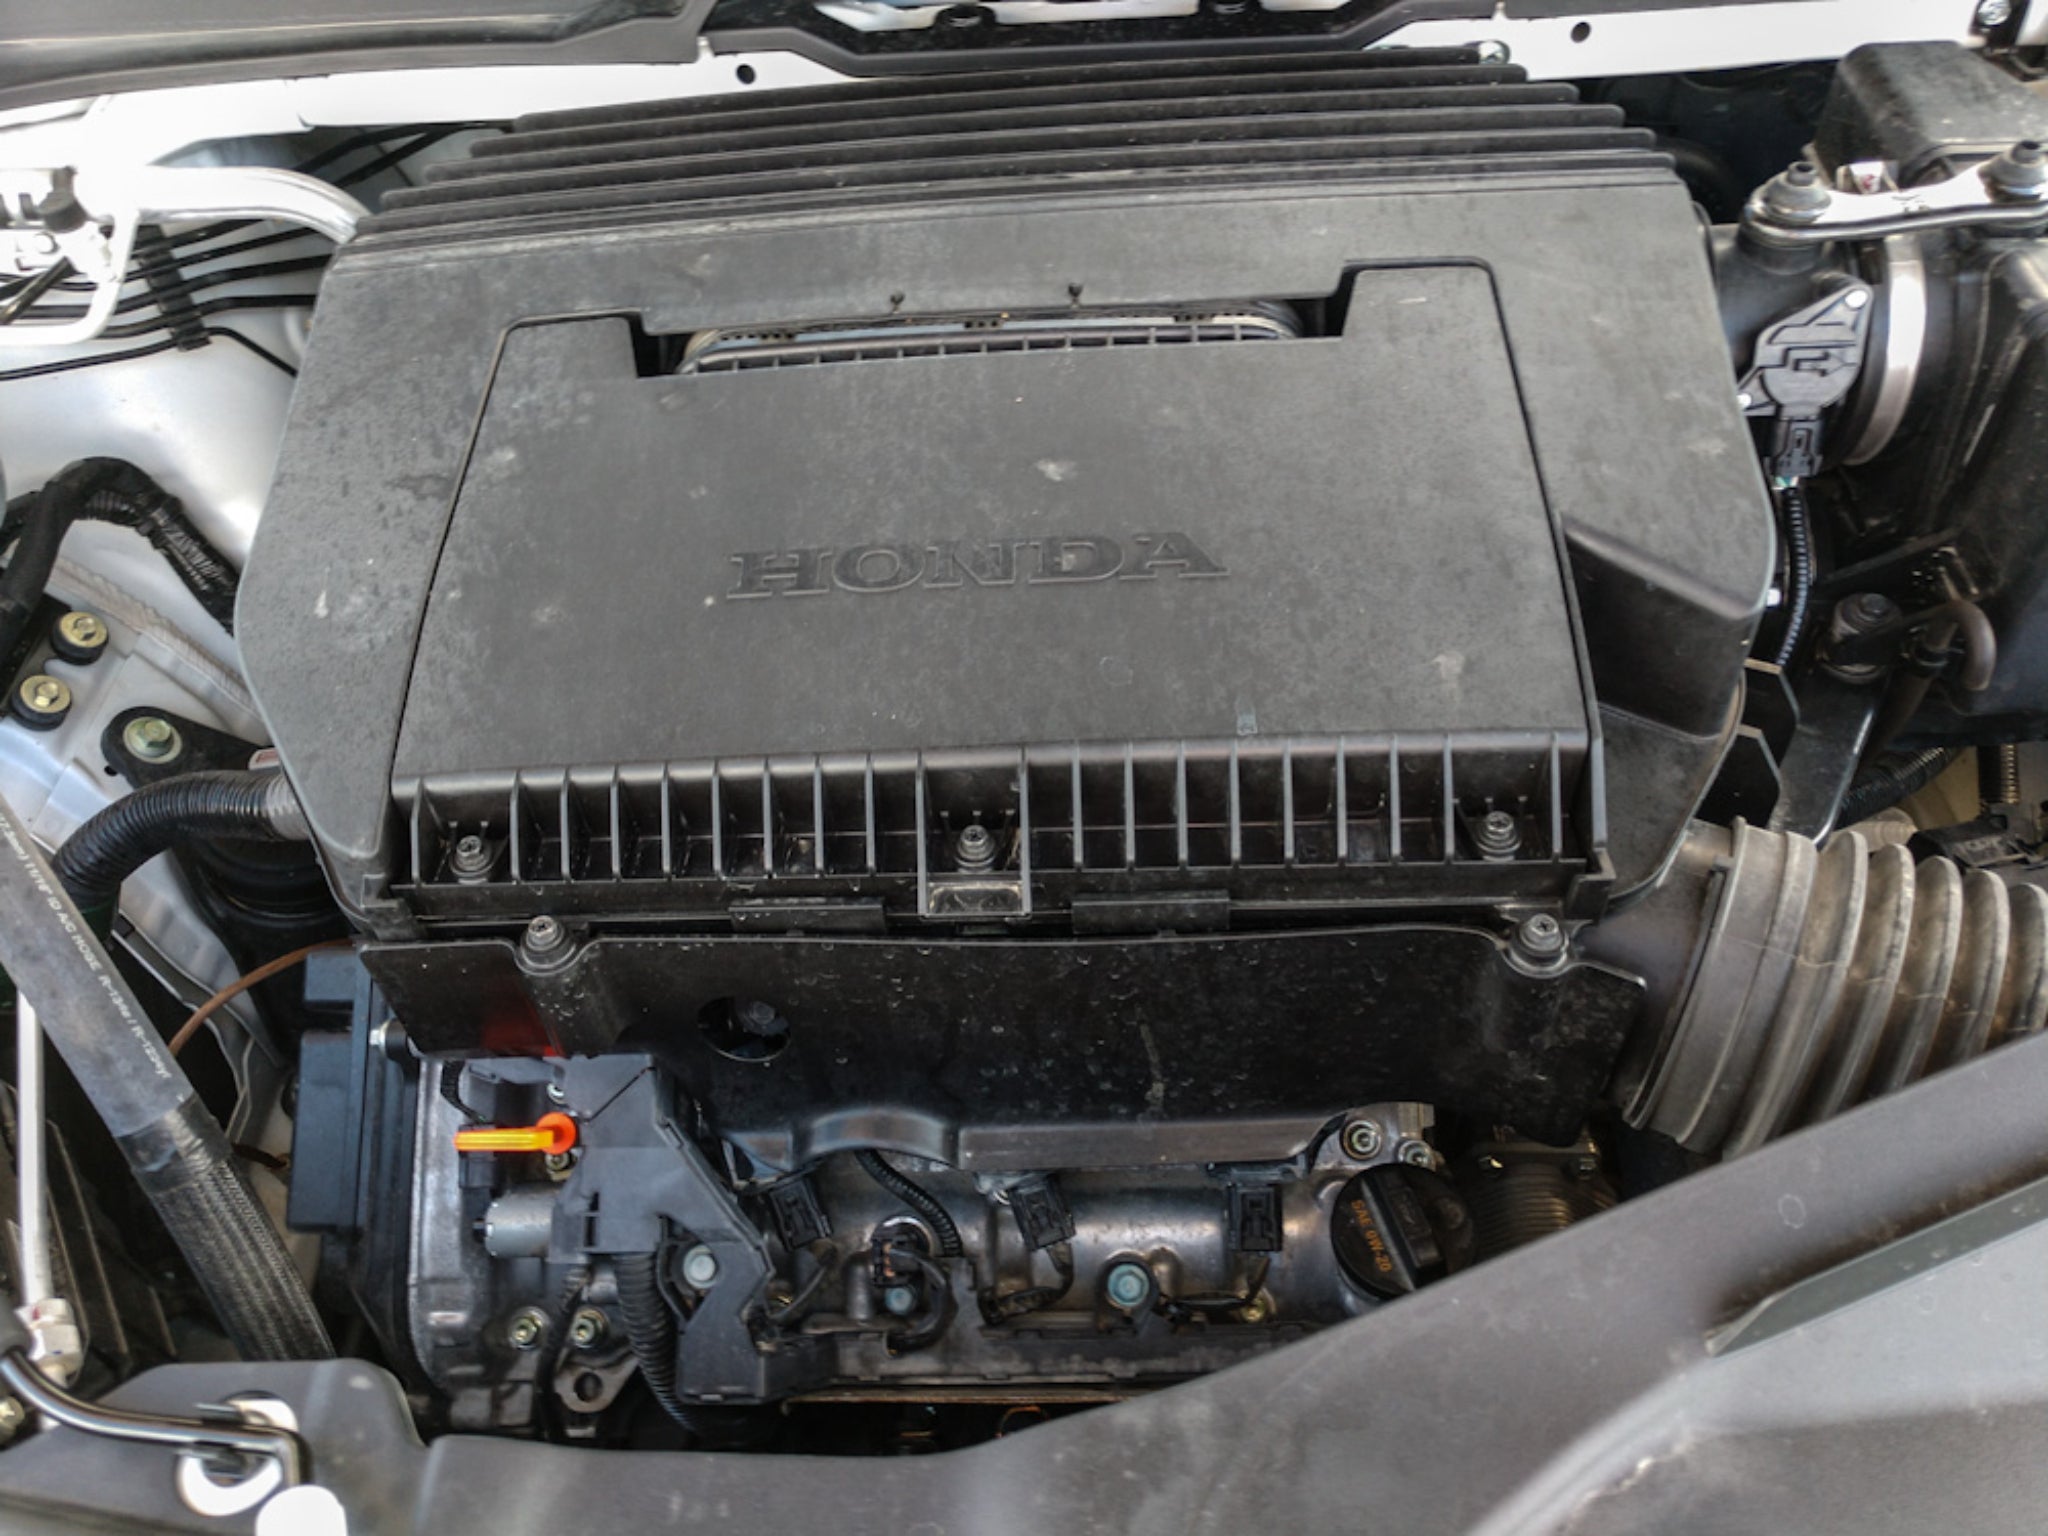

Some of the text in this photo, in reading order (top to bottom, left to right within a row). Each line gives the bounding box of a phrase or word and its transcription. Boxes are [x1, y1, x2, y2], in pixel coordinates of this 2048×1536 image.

[726, 531, 1231, 599] HONDA
[72, 934, 101, 971] HOSE
[1351, 1199, 1393, 1273] SAE 0W-20
